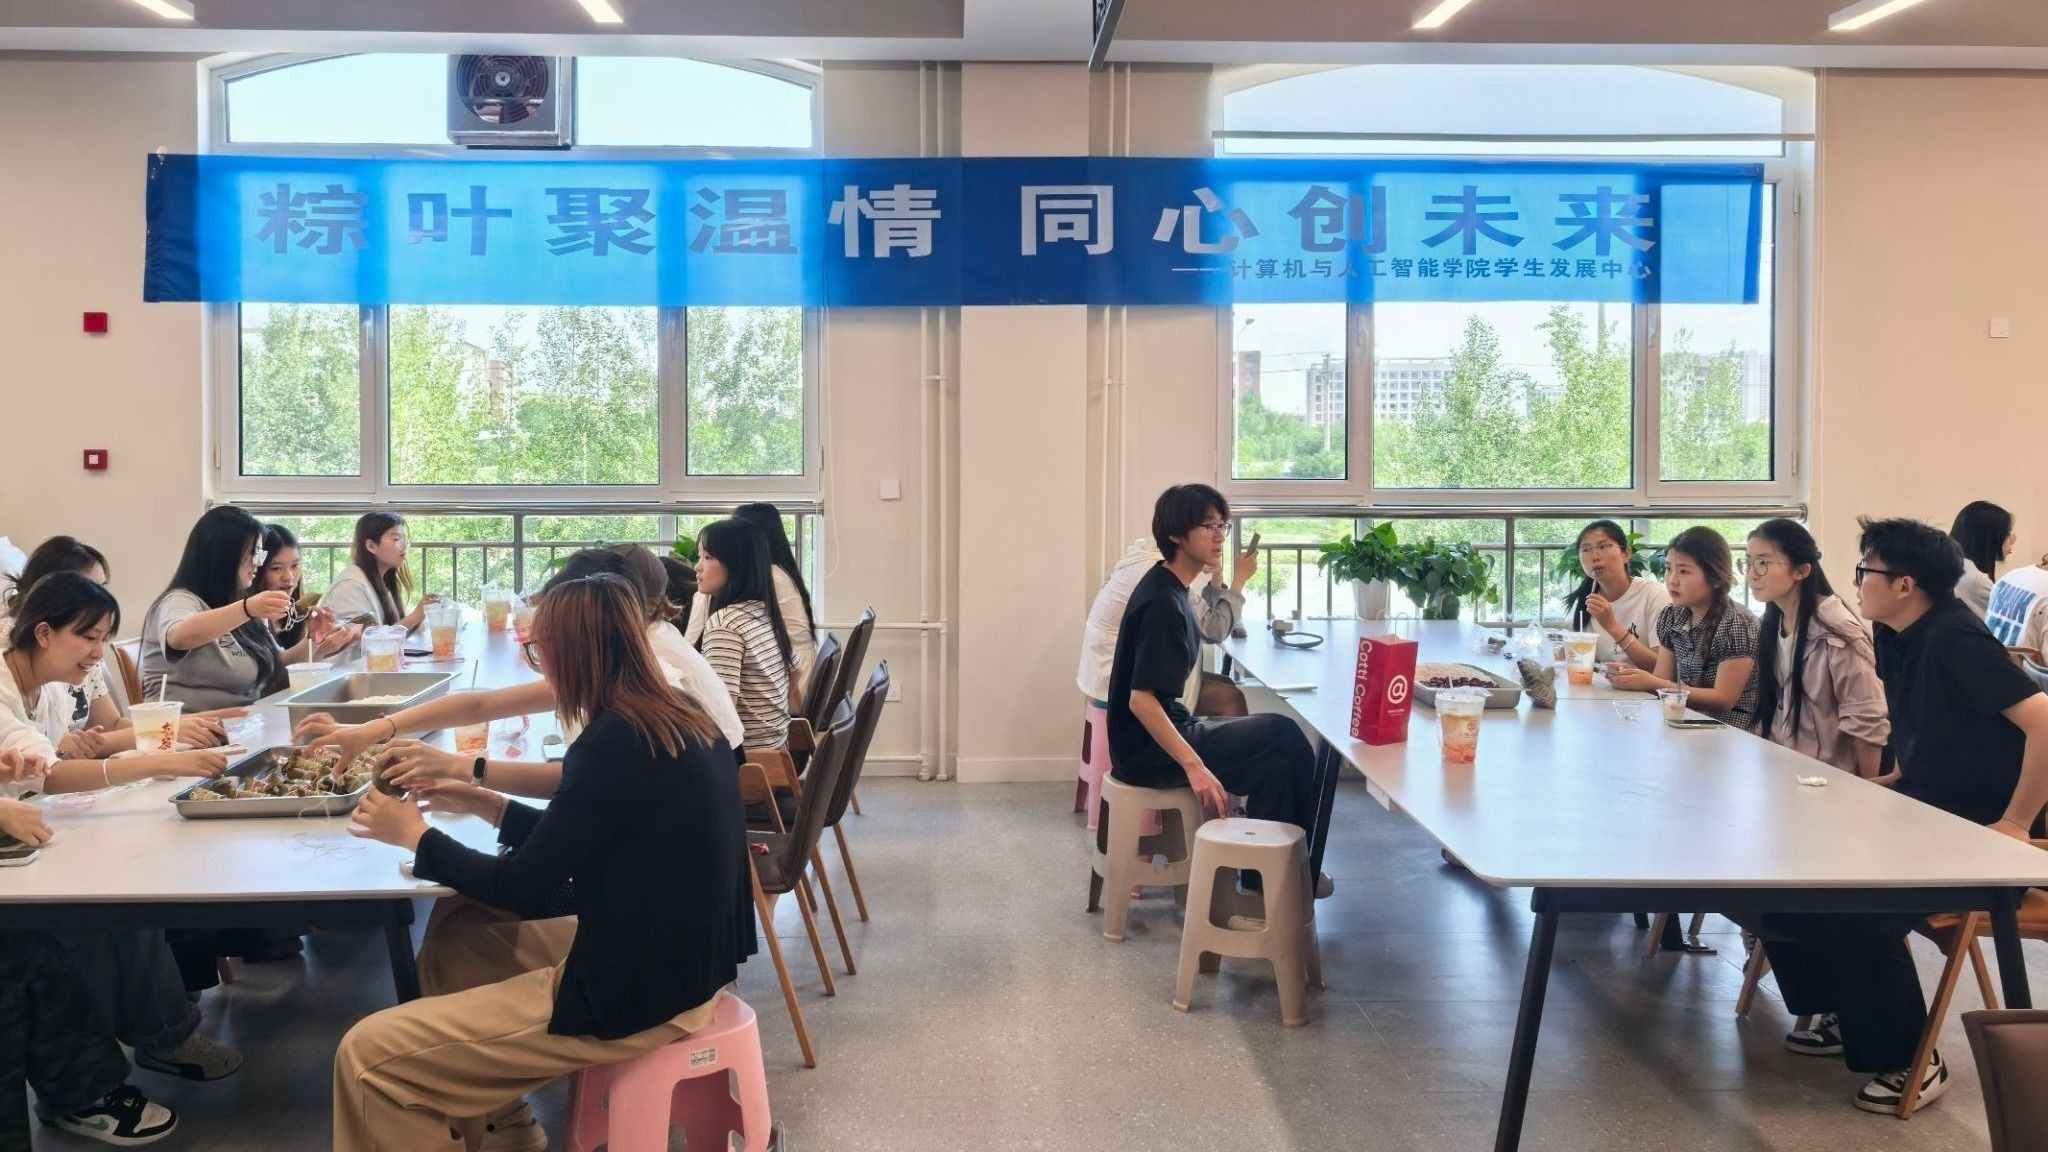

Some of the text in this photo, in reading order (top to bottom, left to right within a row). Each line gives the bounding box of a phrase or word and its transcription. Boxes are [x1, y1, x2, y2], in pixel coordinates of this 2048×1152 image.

[256, 183, 1656, 258] 粽叶聚温情 同心创未来
[1351, 640, 1372, 737] Cotti Coffee
